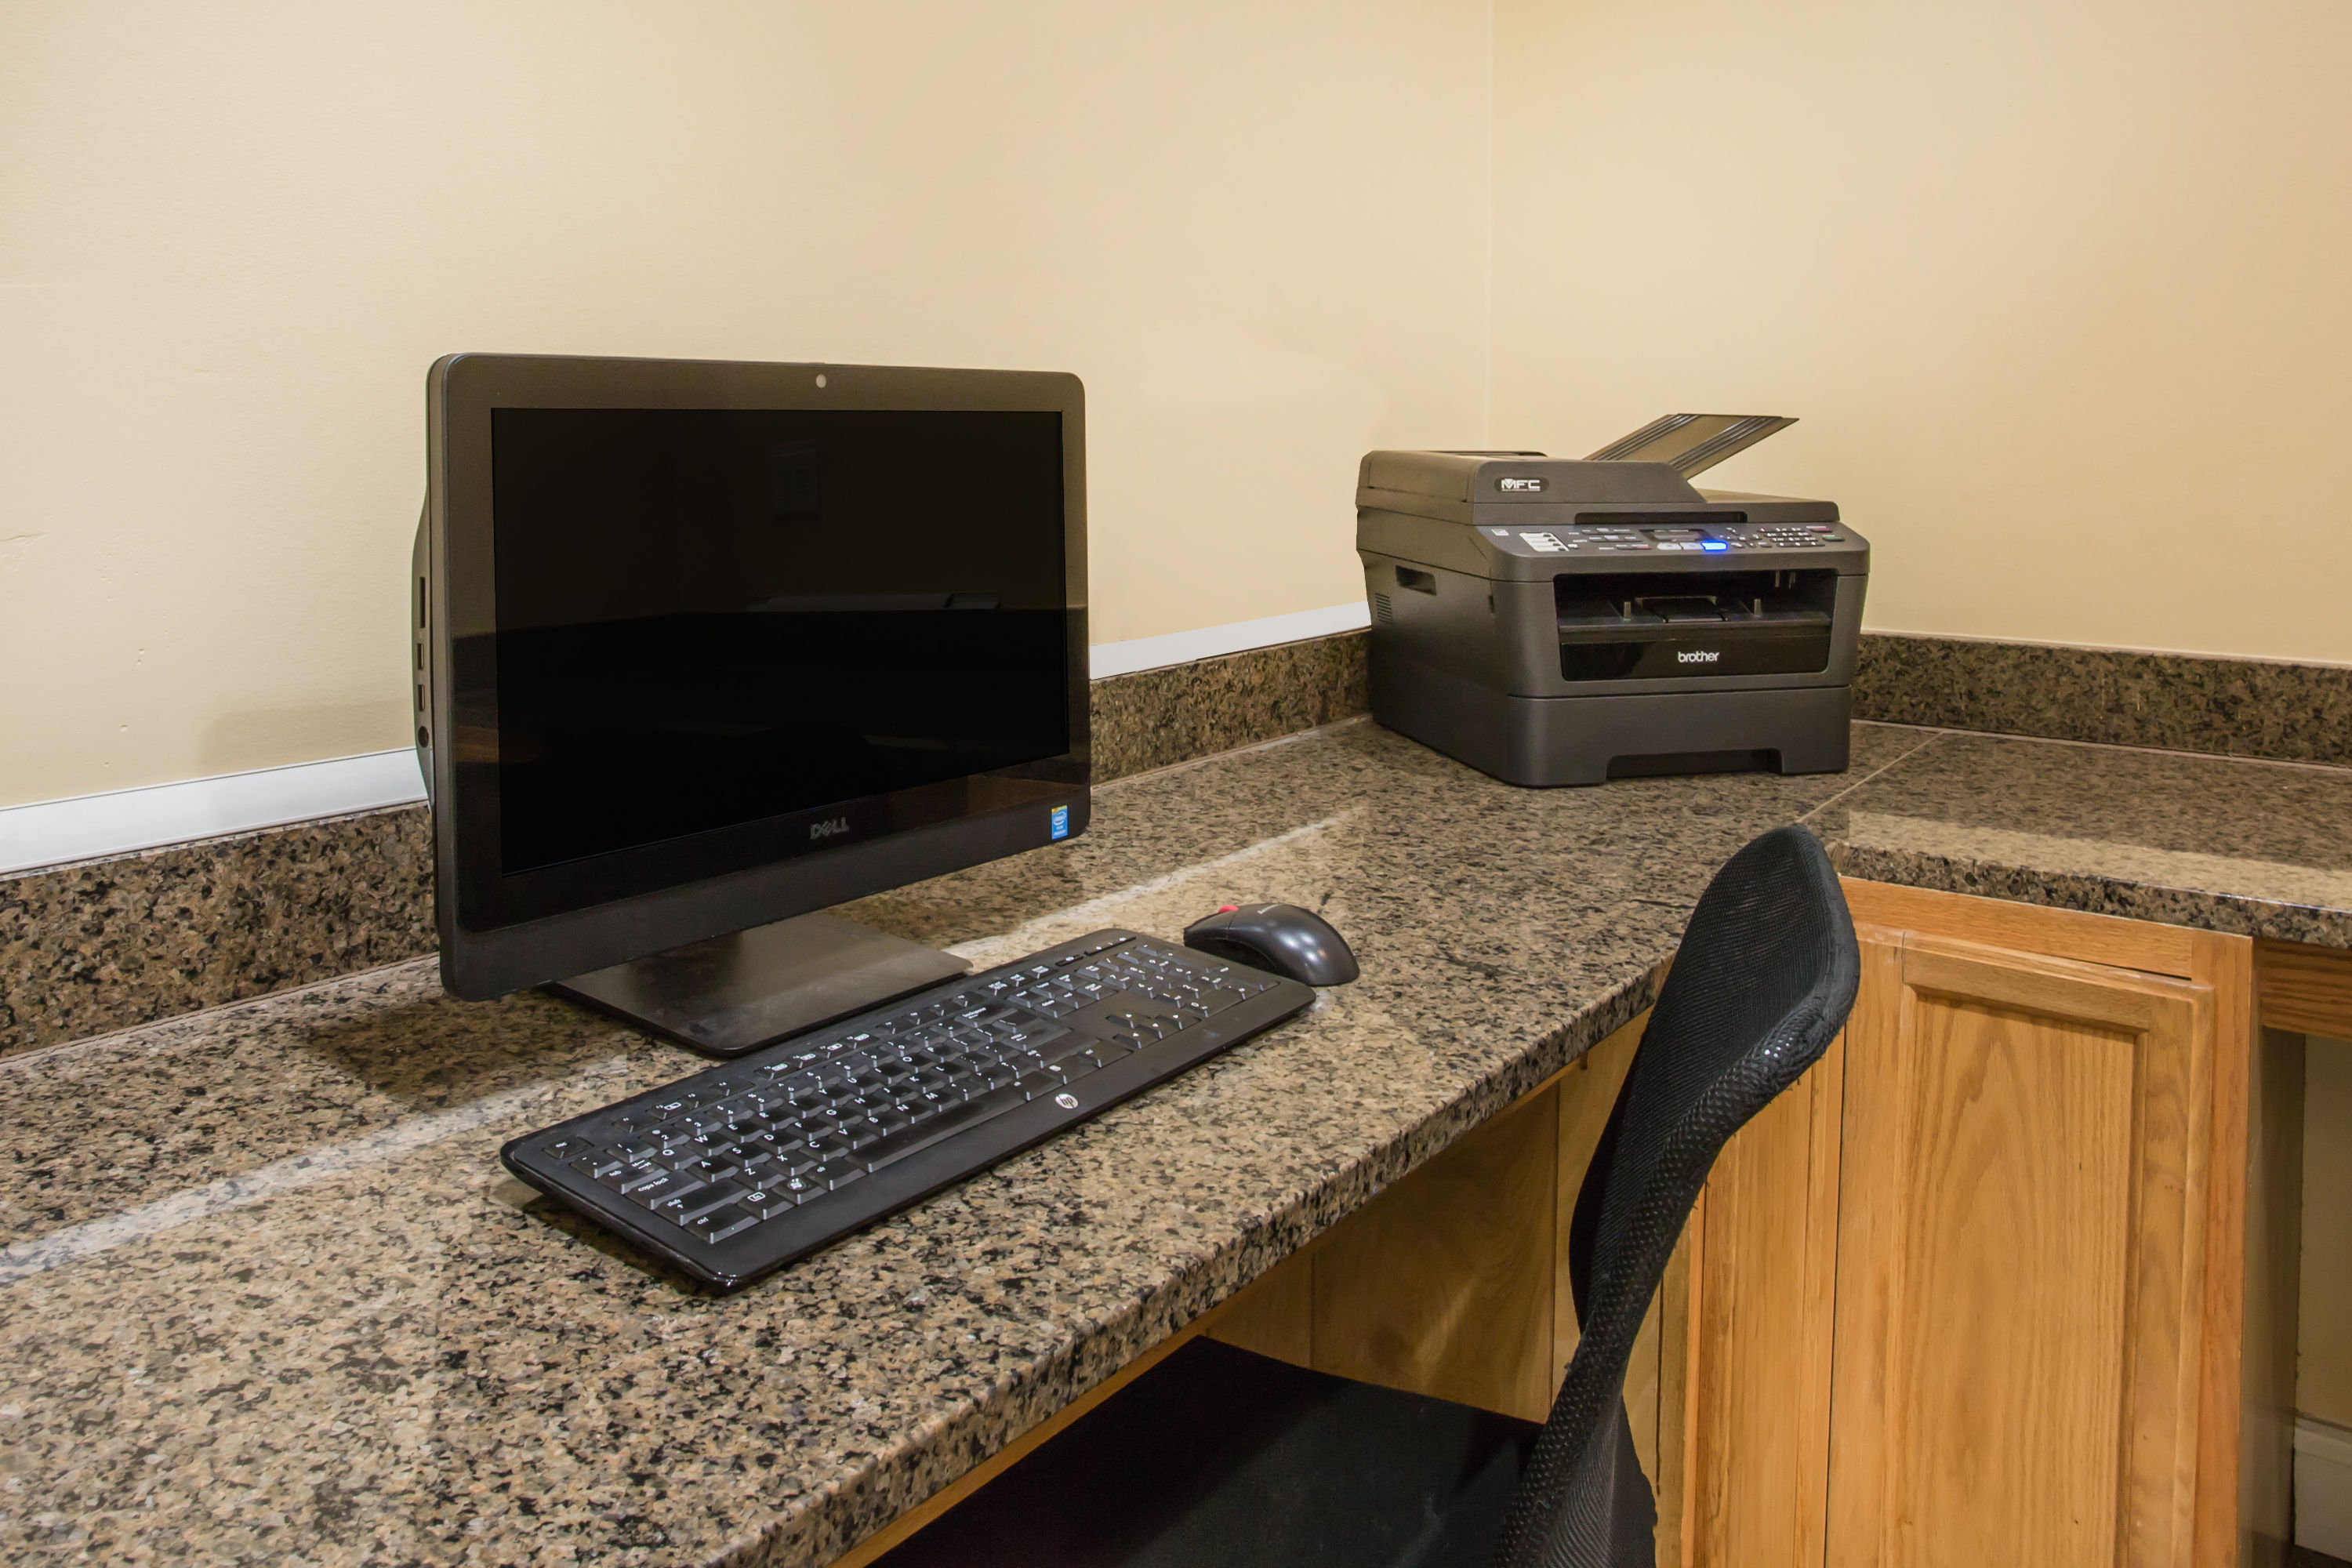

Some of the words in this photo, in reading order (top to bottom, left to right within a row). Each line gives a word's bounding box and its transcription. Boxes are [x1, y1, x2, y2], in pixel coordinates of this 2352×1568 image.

[1501, 478, 1541, 489] MFC
[1678, 651, 1720, 663] brother
[810, 816, 850, 840] DELL
